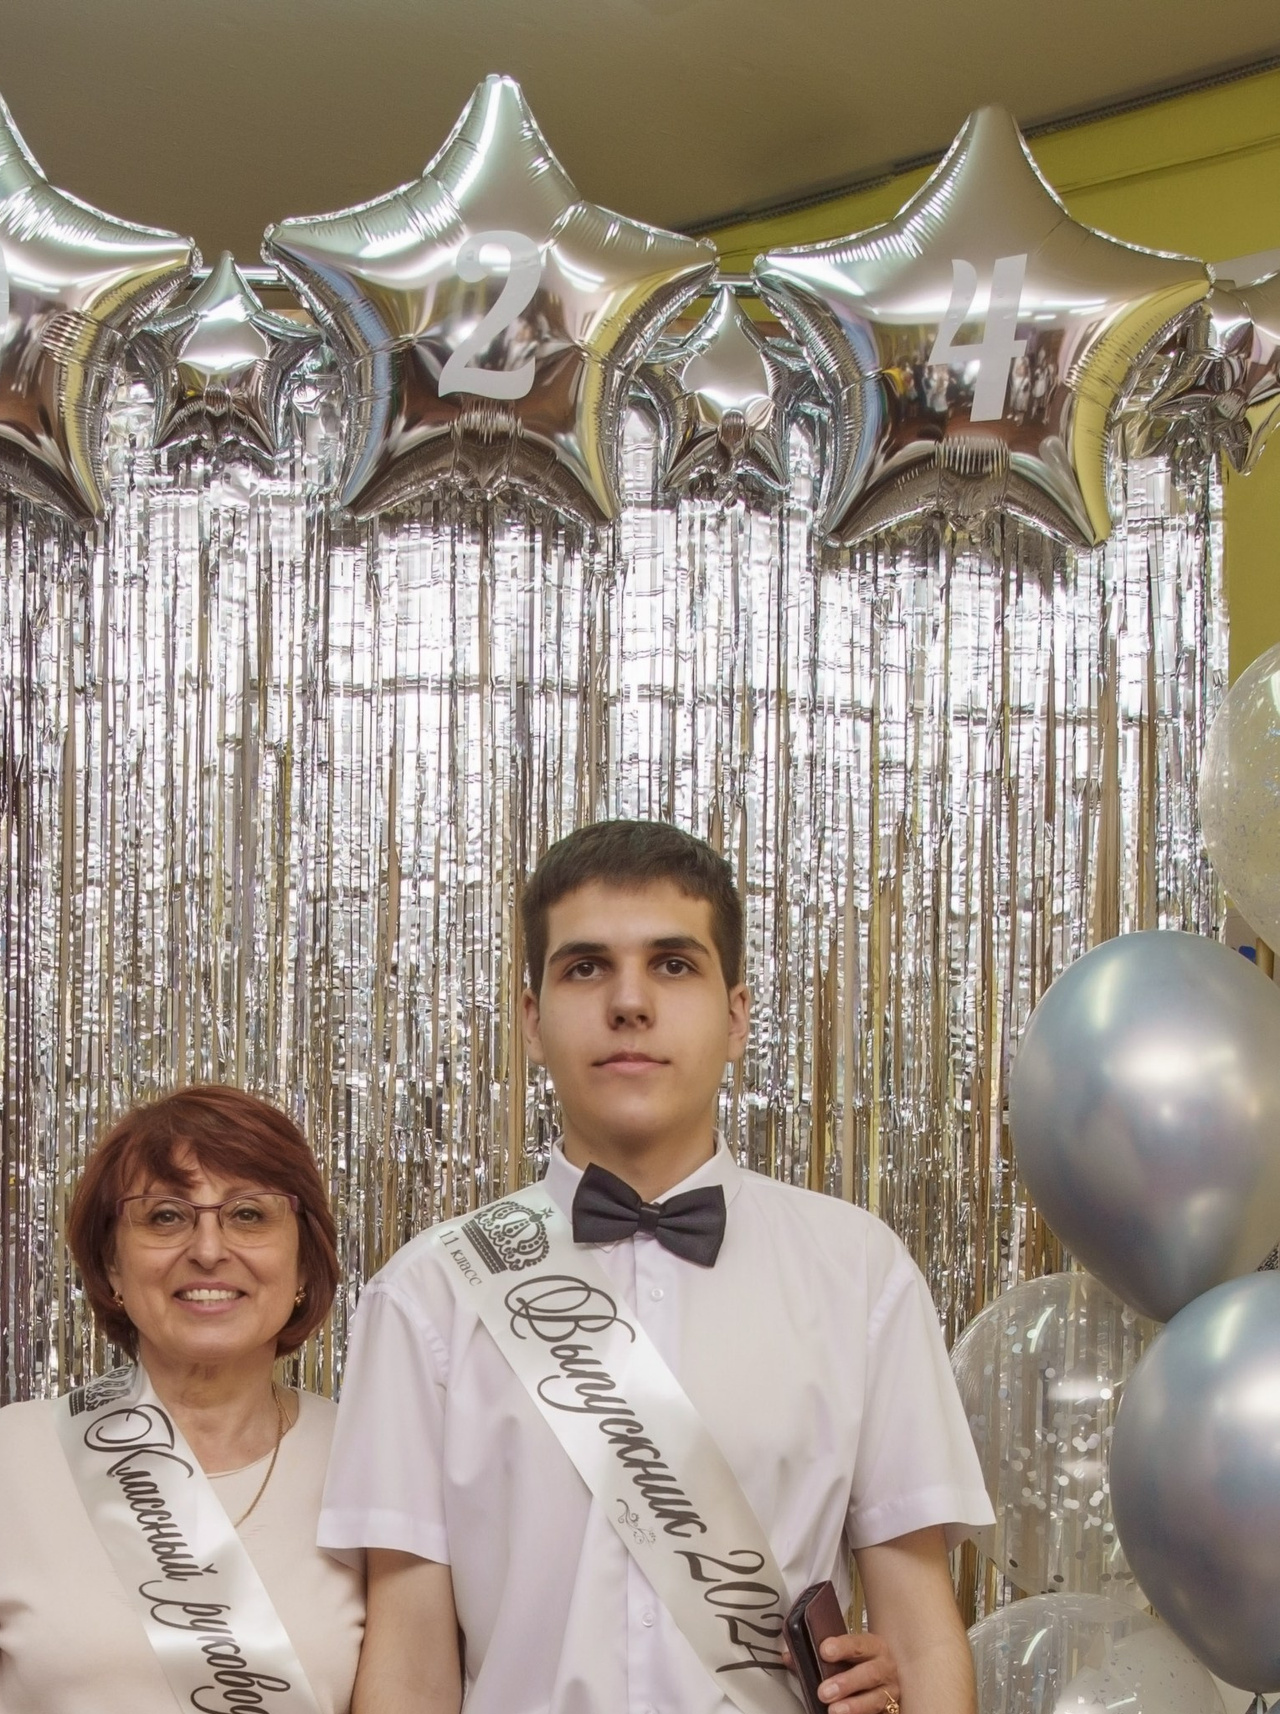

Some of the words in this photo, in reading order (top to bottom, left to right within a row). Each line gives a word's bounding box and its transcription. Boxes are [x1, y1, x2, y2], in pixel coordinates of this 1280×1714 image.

[438, 230, 542, 400] 2
[929, 252, 1028, 421] 4
[440, 1230, 459, 1246] 11
[450, 1249, 483, 1286] класс
[84, 1403, 218, 1582] Классный
[504, 1275, 707, 1538] Выпускник
